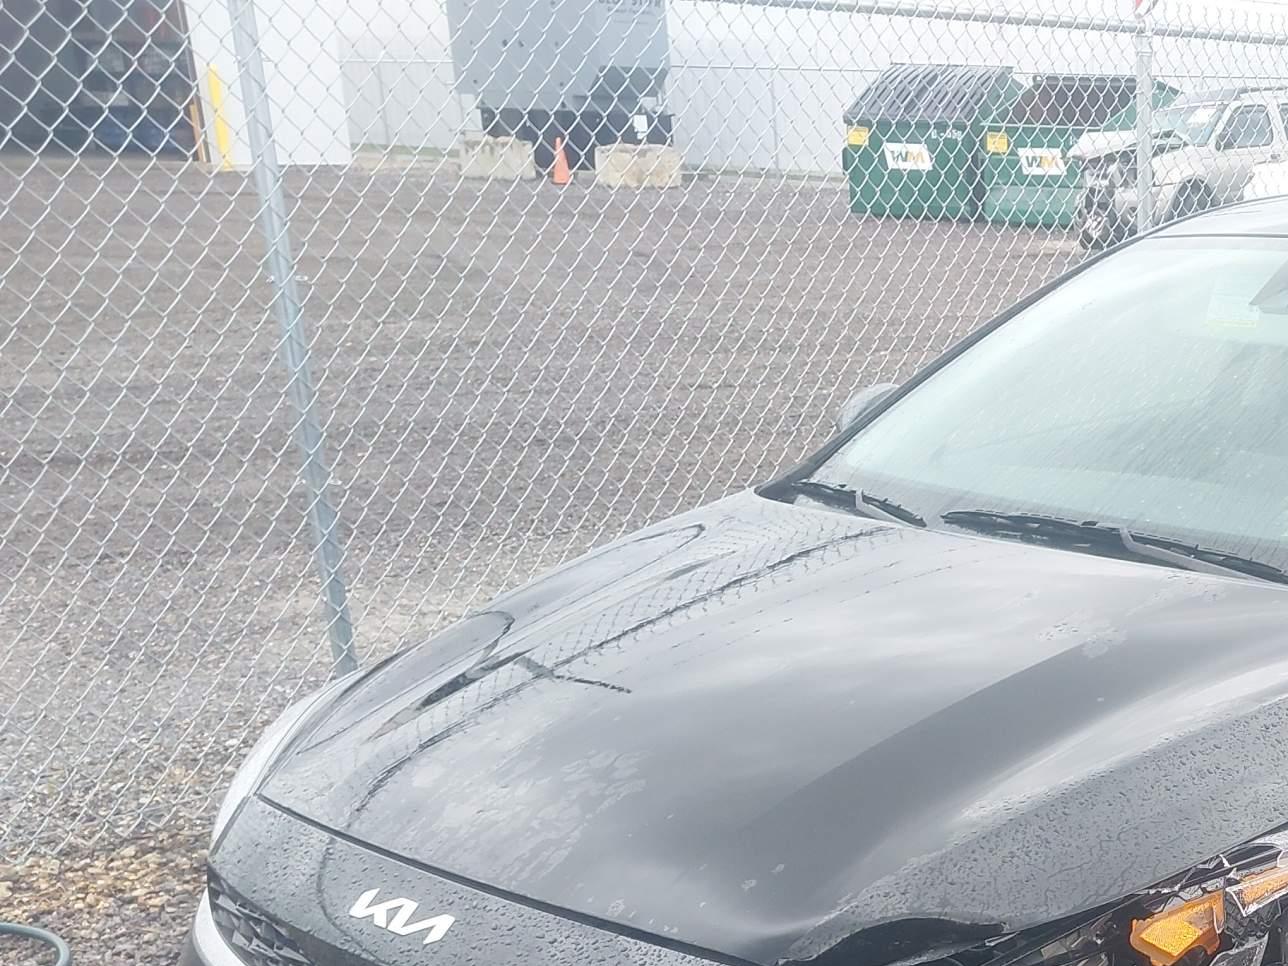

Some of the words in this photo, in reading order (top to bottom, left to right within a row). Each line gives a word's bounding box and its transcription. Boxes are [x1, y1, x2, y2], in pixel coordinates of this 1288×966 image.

[889, 150, 925, 164] WM
[1025, 153, 1060, 169] WM
[348, 887, 456, 945] KIA
